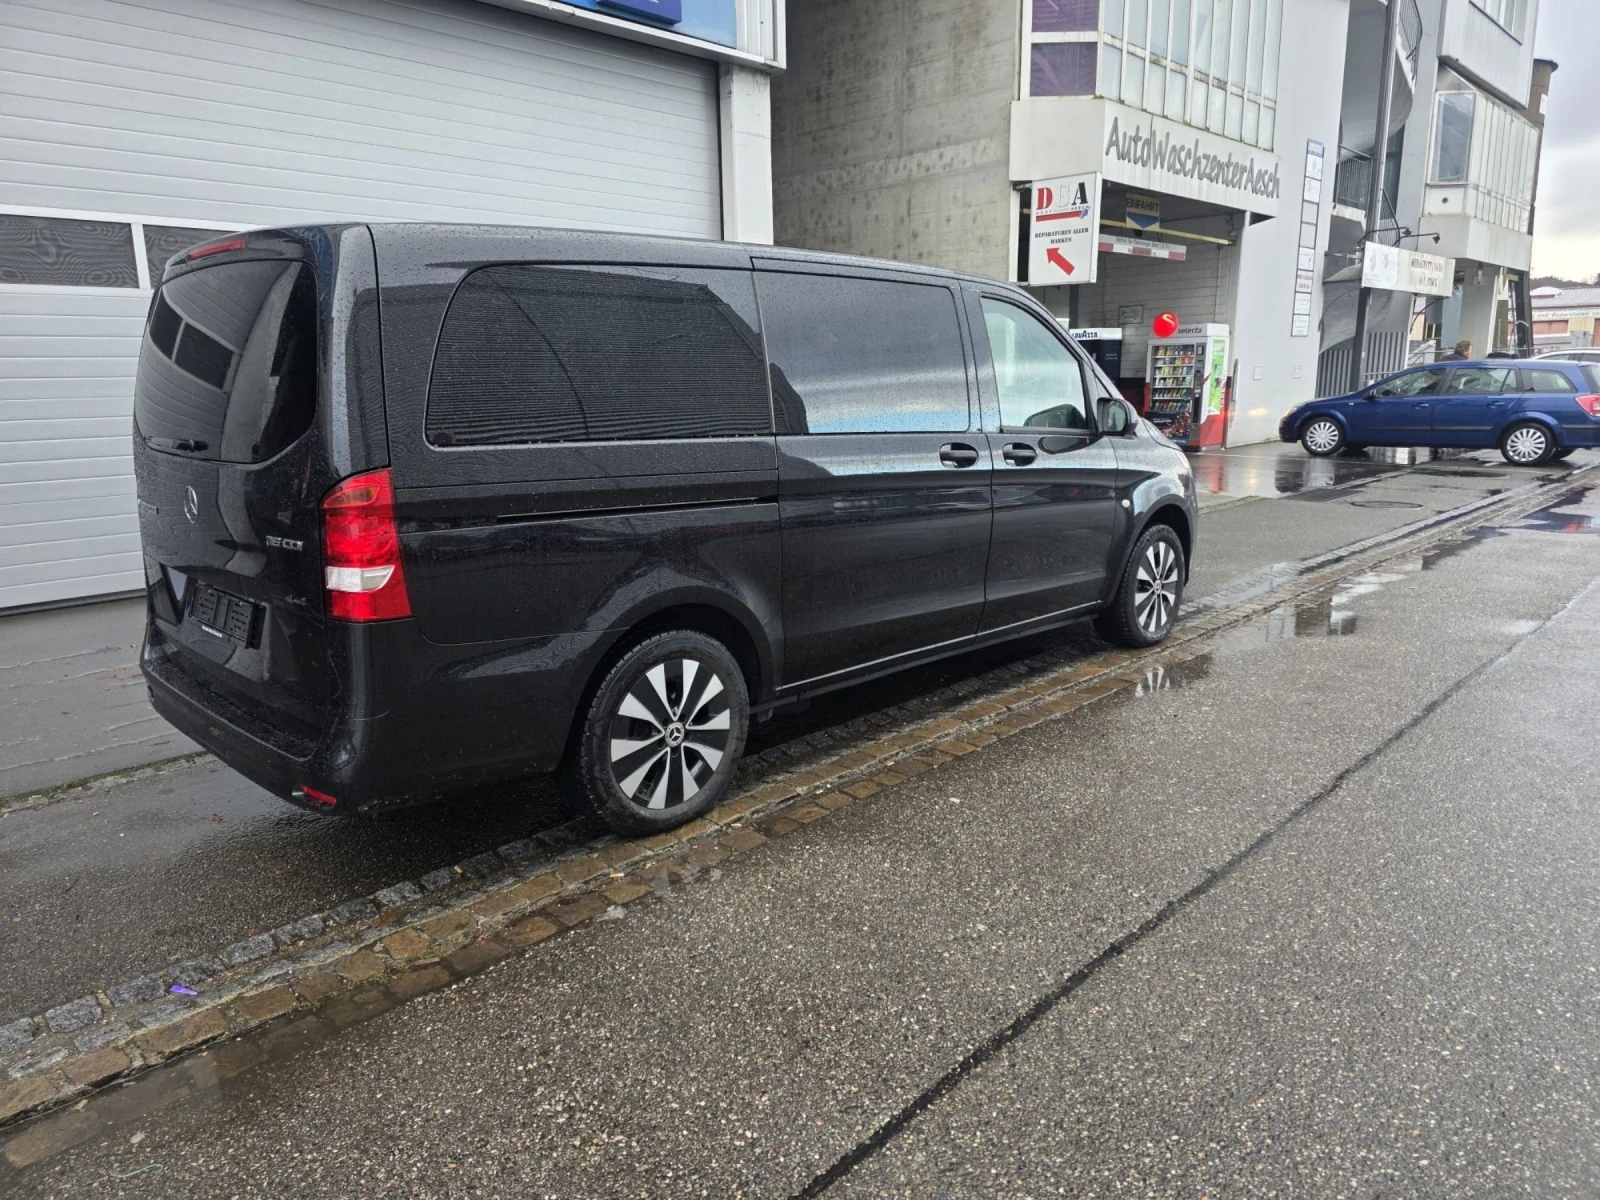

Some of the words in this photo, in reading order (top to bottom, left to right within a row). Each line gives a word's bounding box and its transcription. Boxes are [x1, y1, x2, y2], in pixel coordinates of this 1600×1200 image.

[1126, 197, 1159, 213] EINFAHRT
[1034, 229, 1072, 239] REPARATUREN
[1073, 227, 1089, 235] ALLER
[1050, 237, 1072, 245] MARKEN
[1551, 311, 1589, 319] Reparaturen
[1177, 326, 1202, 334] selecta
[282, 538, 304, 552] CDI
